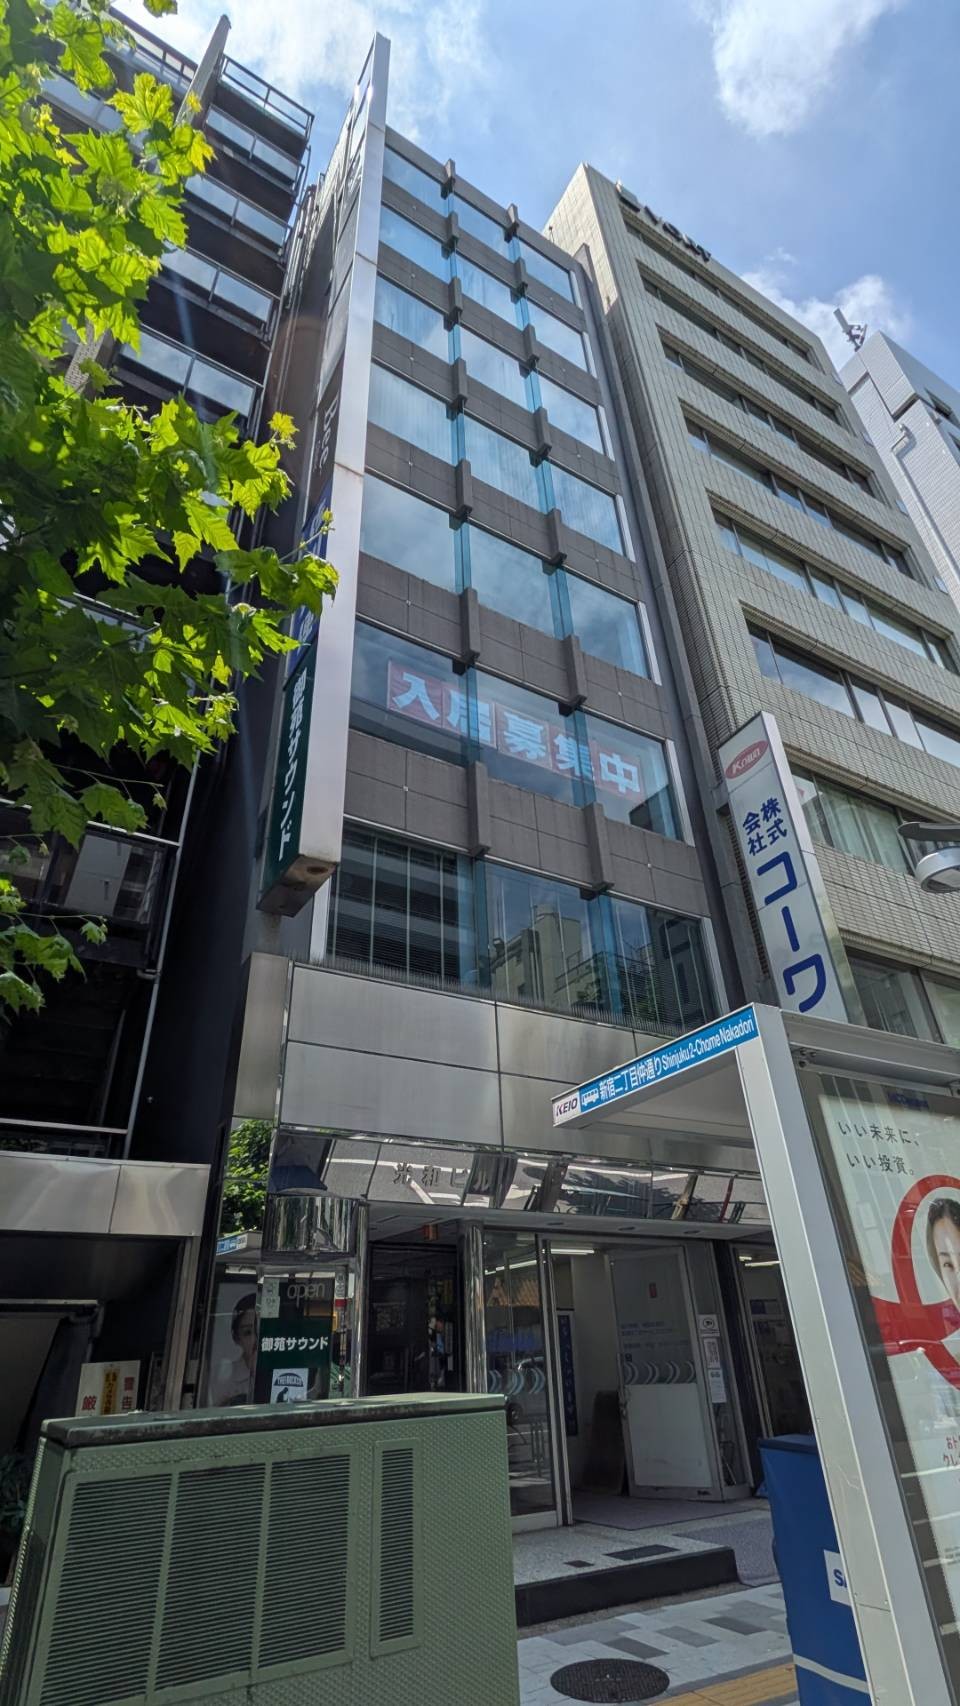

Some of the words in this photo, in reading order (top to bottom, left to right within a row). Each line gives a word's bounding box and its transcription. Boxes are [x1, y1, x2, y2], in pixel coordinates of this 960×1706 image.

[756, 851, 827, 1013] コーワ
[599, 1056, 663, 1102] 新宿二丁目仲通り
[719, 1015, 755, 1045] Nakadori
[556, 1098, 578, 1117] KEIO
[838, 1121, 919, 1147] いい未来に、
[846, 1153, 915, 1176] いい投資。
[287, 1282, 326, 1309] open
[261, 1336, 329, 1353] 御苑サウンド
[833, 1568, 848, 1589] S
